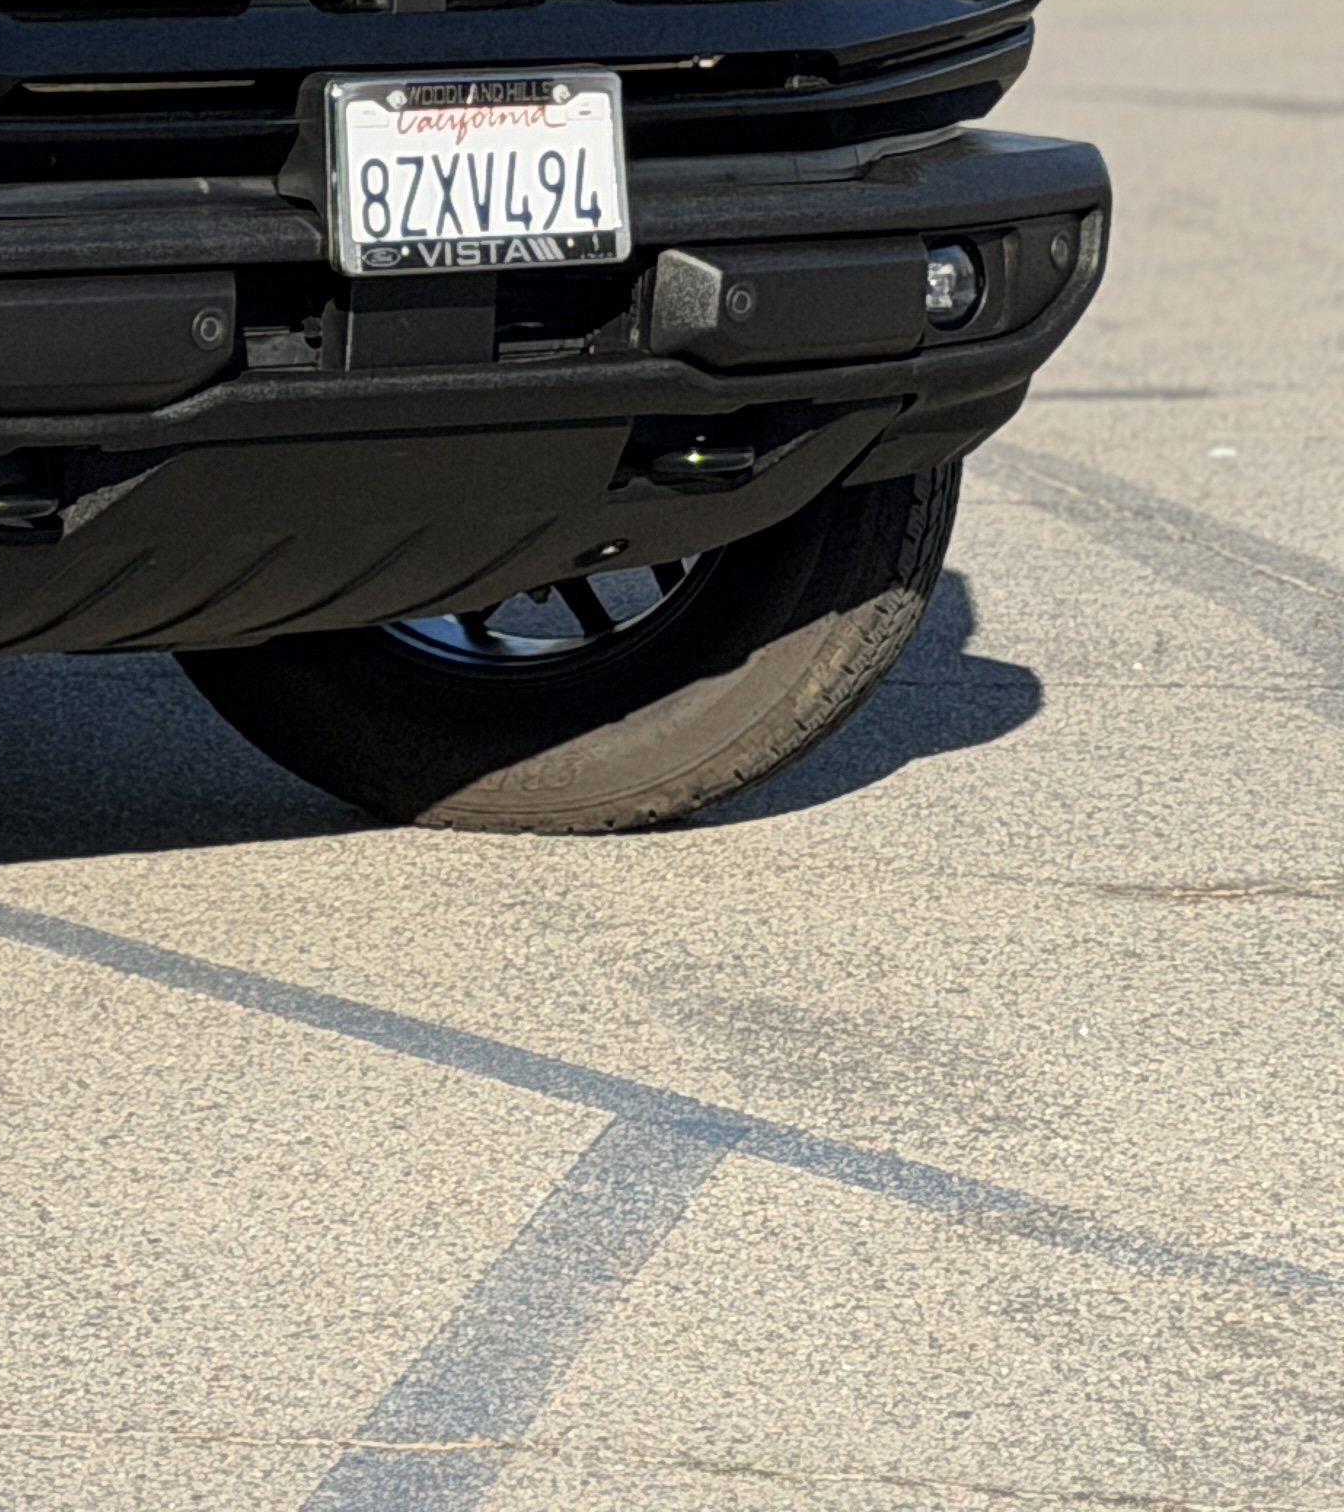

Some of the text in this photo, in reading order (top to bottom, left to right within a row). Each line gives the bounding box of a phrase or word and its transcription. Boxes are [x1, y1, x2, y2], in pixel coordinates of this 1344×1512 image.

[407, 80, 552, 105] WOODLAND HILLS
[360, 147, 602, 239] 8ZXV494
[417, 240, 530, 267] VISTA
